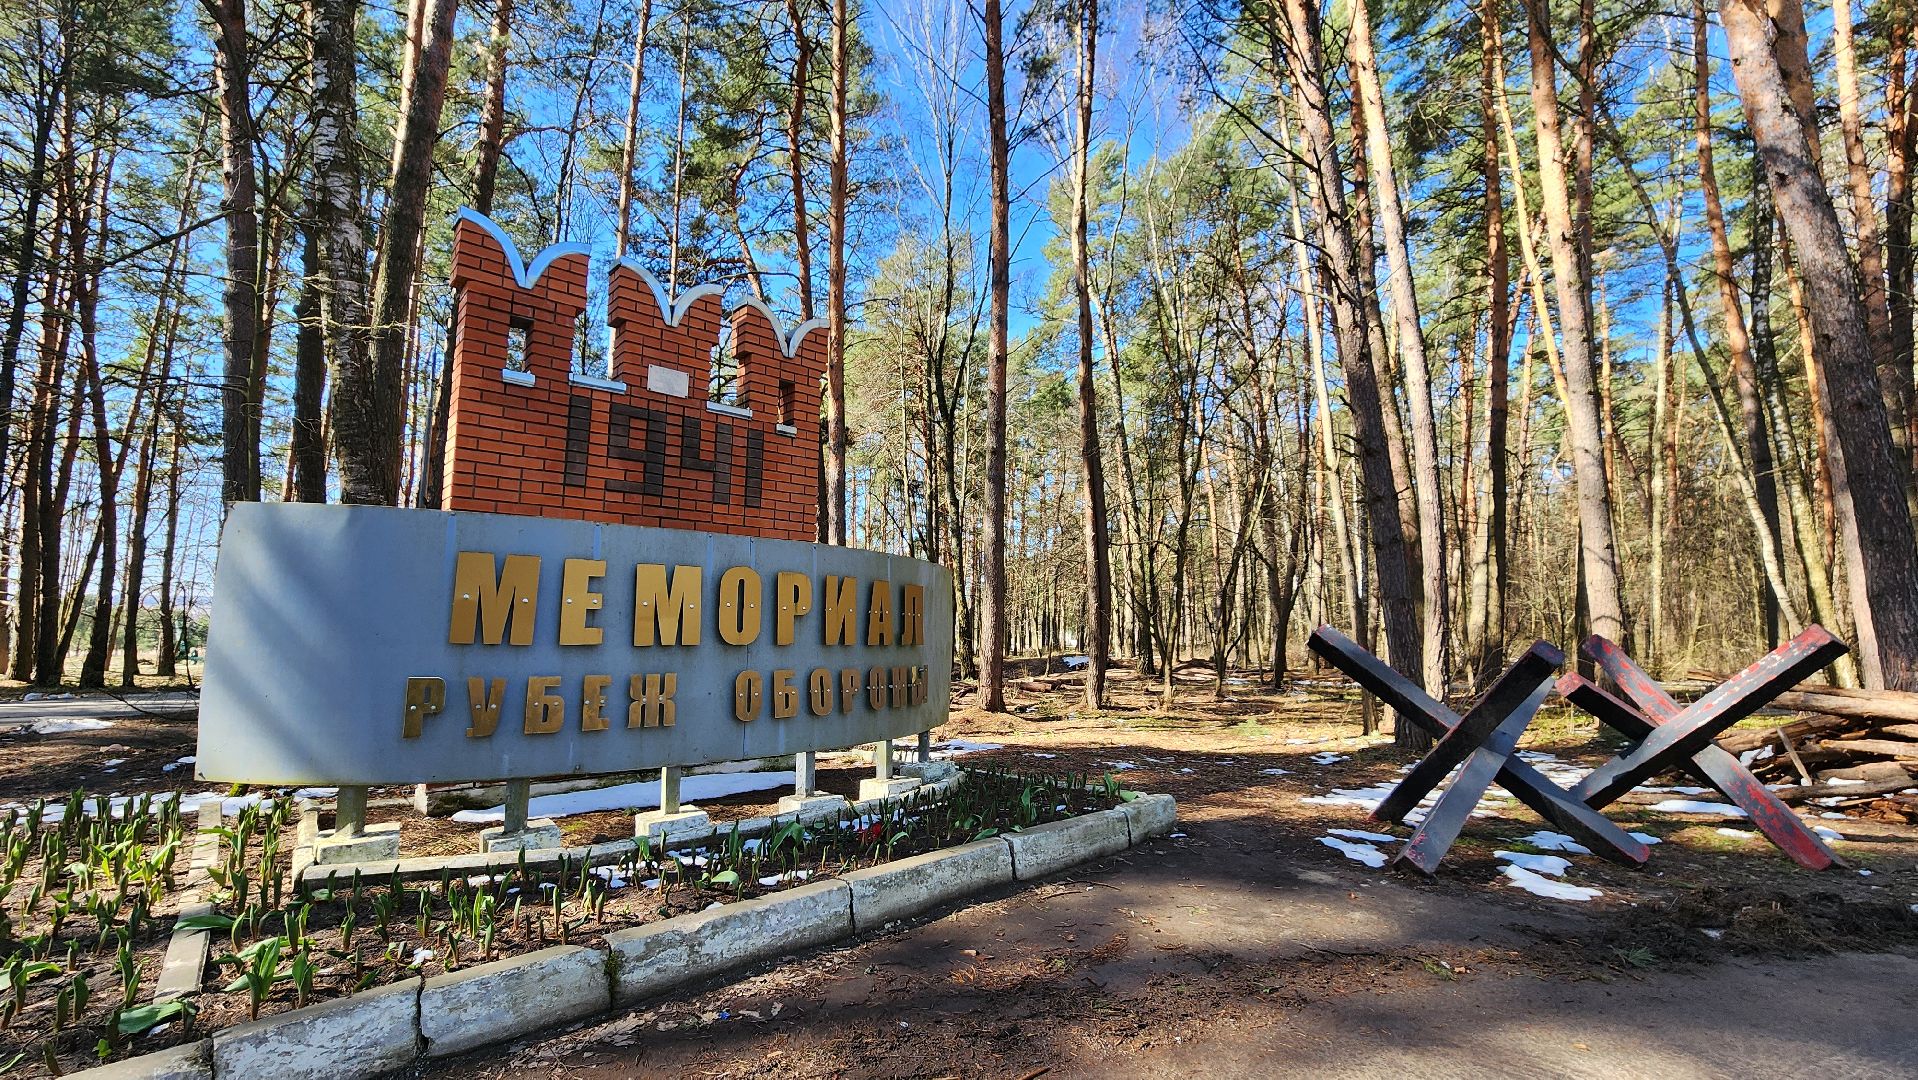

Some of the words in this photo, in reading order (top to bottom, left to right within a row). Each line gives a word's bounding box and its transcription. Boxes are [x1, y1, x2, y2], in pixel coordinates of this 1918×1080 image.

[565, 395, 764, 508] 1941
[449, 551, 924, 646] МЕМОРИАЛ
[403, 672, 678, 738] РУБЕЖ
[734, 665, 928, 722] ОБОРОНЫ
